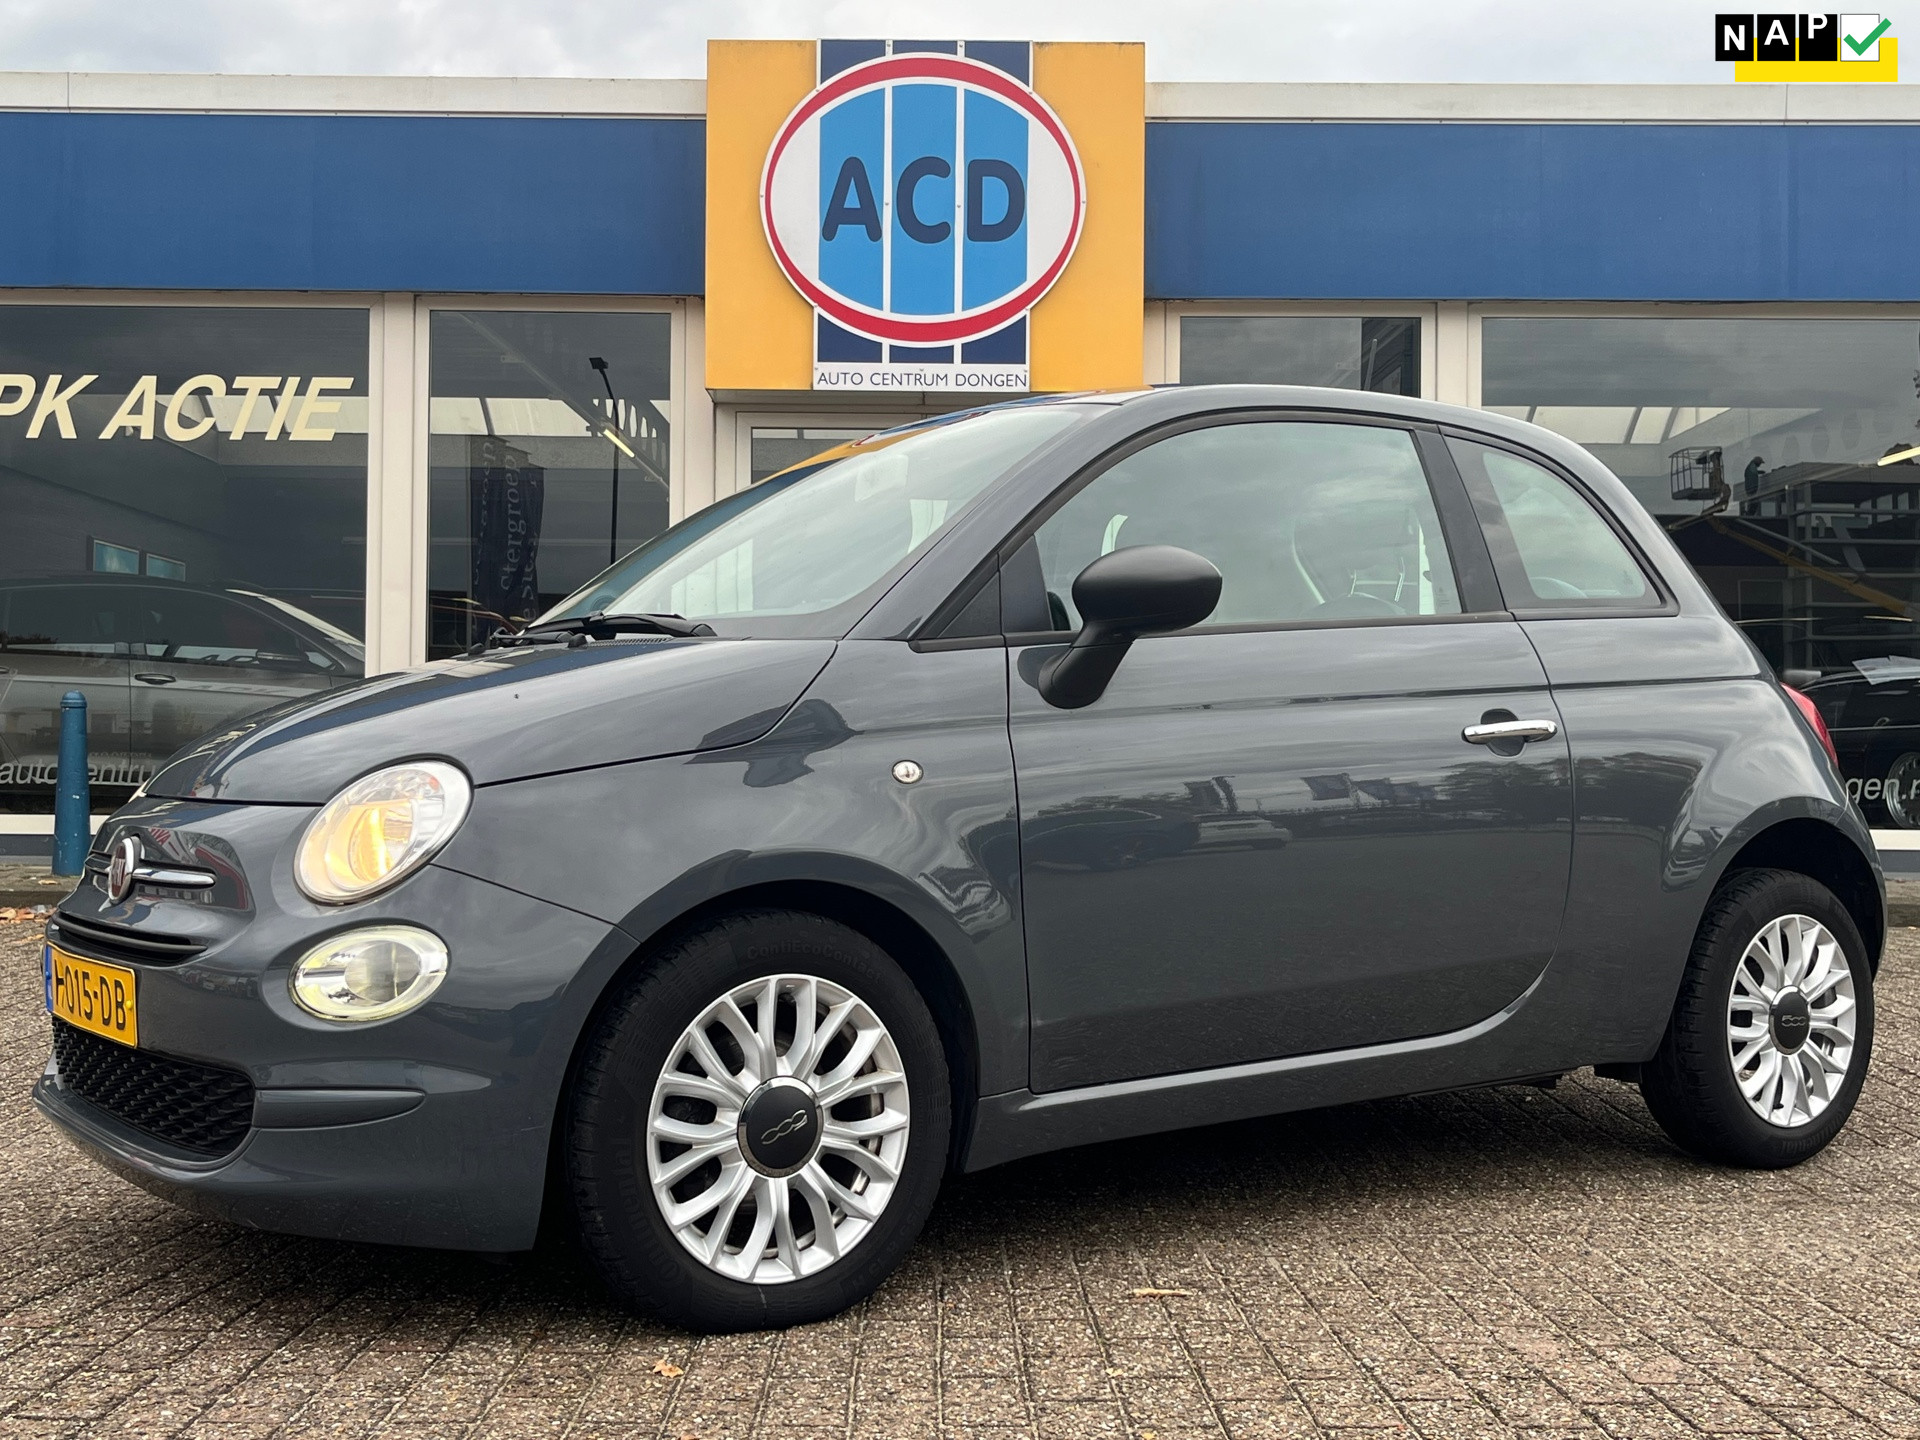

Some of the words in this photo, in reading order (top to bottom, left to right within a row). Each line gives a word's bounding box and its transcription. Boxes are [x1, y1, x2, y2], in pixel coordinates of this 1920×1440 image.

[822, 156, 1025, 244] ACD
[817, 372, 864, 386] AUTO
[869, 372, 949, 387] CENTRUM
[955, 372, 1027, 388] DONGEN
[100, 374, 354, 441] ACTIE
[1781, 1014, 1807, 1027] 500
